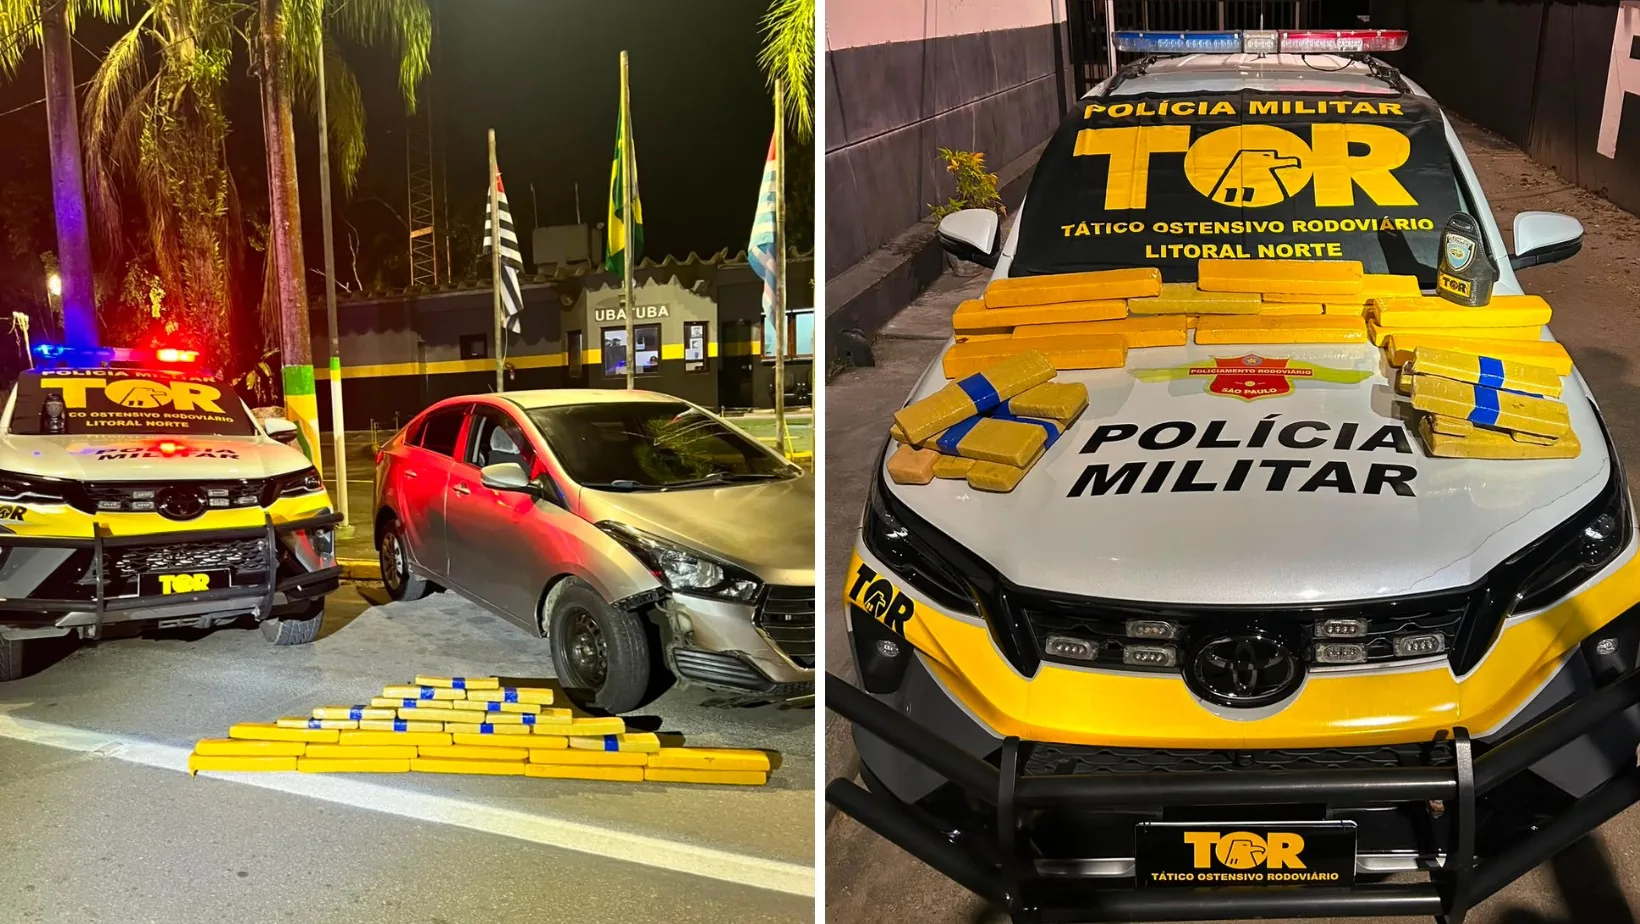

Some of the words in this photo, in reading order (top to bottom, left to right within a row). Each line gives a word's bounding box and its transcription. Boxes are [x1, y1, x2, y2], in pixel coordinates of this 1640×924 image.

[1083, 100, 1236, 119] POLÍCIA
[1249, 100, 1404, 116] MILITAR
[1073, 123, 1419, 210] TOR
[1061, 219, 1145, 237] TÁTICO
[1152, 219, 1285, 235] OSTENSIVO
[1292, 216, 1434, 233] RODOVIÁRIO
[1145, 244, 1250, 259] LITORAL
[1258, 242, 1344, 258] NORTE
[1442, 276, 1467, 294] TOR
[1257, 367, 1312, 375] RODOVIÁRIO
[40, 377, 227, 413] TOR
[1221, 386, 1242, 394] SÃO
[1244, 386, 1278, 395] PAULO
[86, 419, 141, 427] LITORAL
[143, 420, 190, 428] NORTE
[90, 411, 161, 419] OSTENSIVO
[1078, 413, 1414, 454] POLÍCIA
[1065, 459, 1419, 498] MILITAR
[158, 573, 210, 595] TOR
[849, 562, 915, 639] TOR
[1184, 831, 1307, 870] TOR
[1151, 871, 1194, 881] TÁTICO
[1197, 873, 1263, 881] OSTENSIVO
[1267, 871, 1339, 881] RODOVIÁRIO
